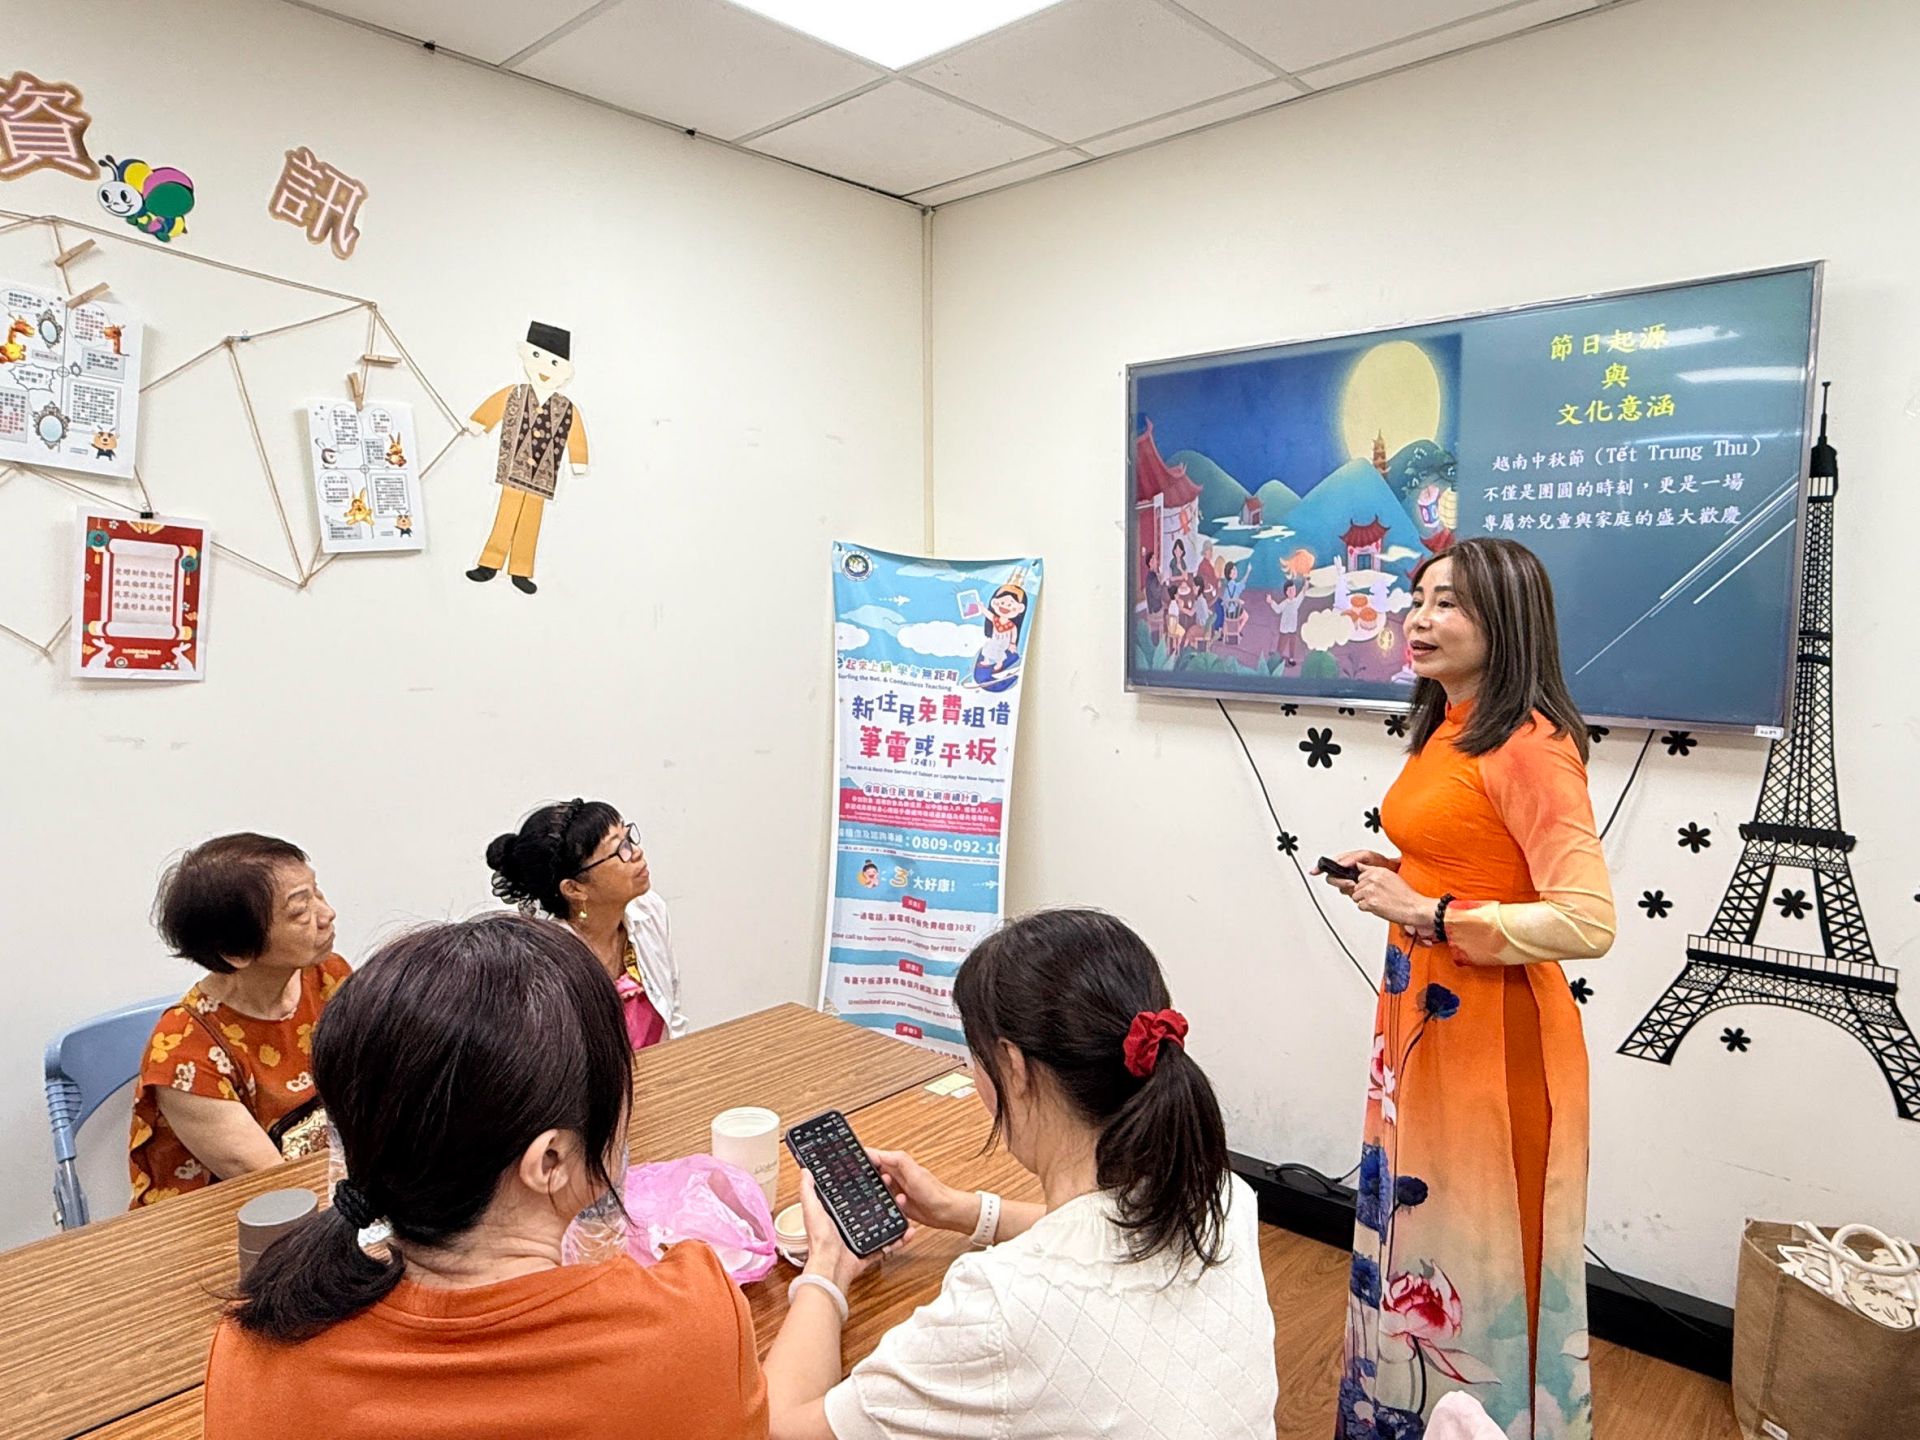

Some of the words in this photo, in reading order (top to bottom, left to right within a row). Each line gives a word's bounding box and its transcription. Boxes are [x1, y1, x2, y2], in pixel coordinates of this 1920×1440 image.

[0, 80, 92, 175] 資
[274, 150, 362, 250] 訊
[1549, 322, 1669, 362] 節日起源
[1602, 362, 1630, 390] 與
[1556, 394, 1676, 426] 文化意涵
[1492, 449, 1585, 472] 越南中秋節
[1648, 444, 1703, 463] Trung
[1713, 437, 1761, 457] Thu)
[1482, 505, 1742, 532] 專屬於兒童與家庭的盛大歡慶
[852, 690, 1011, 728] 新住民免費租借
[859, 725, 997, 768] 筆電或平板
